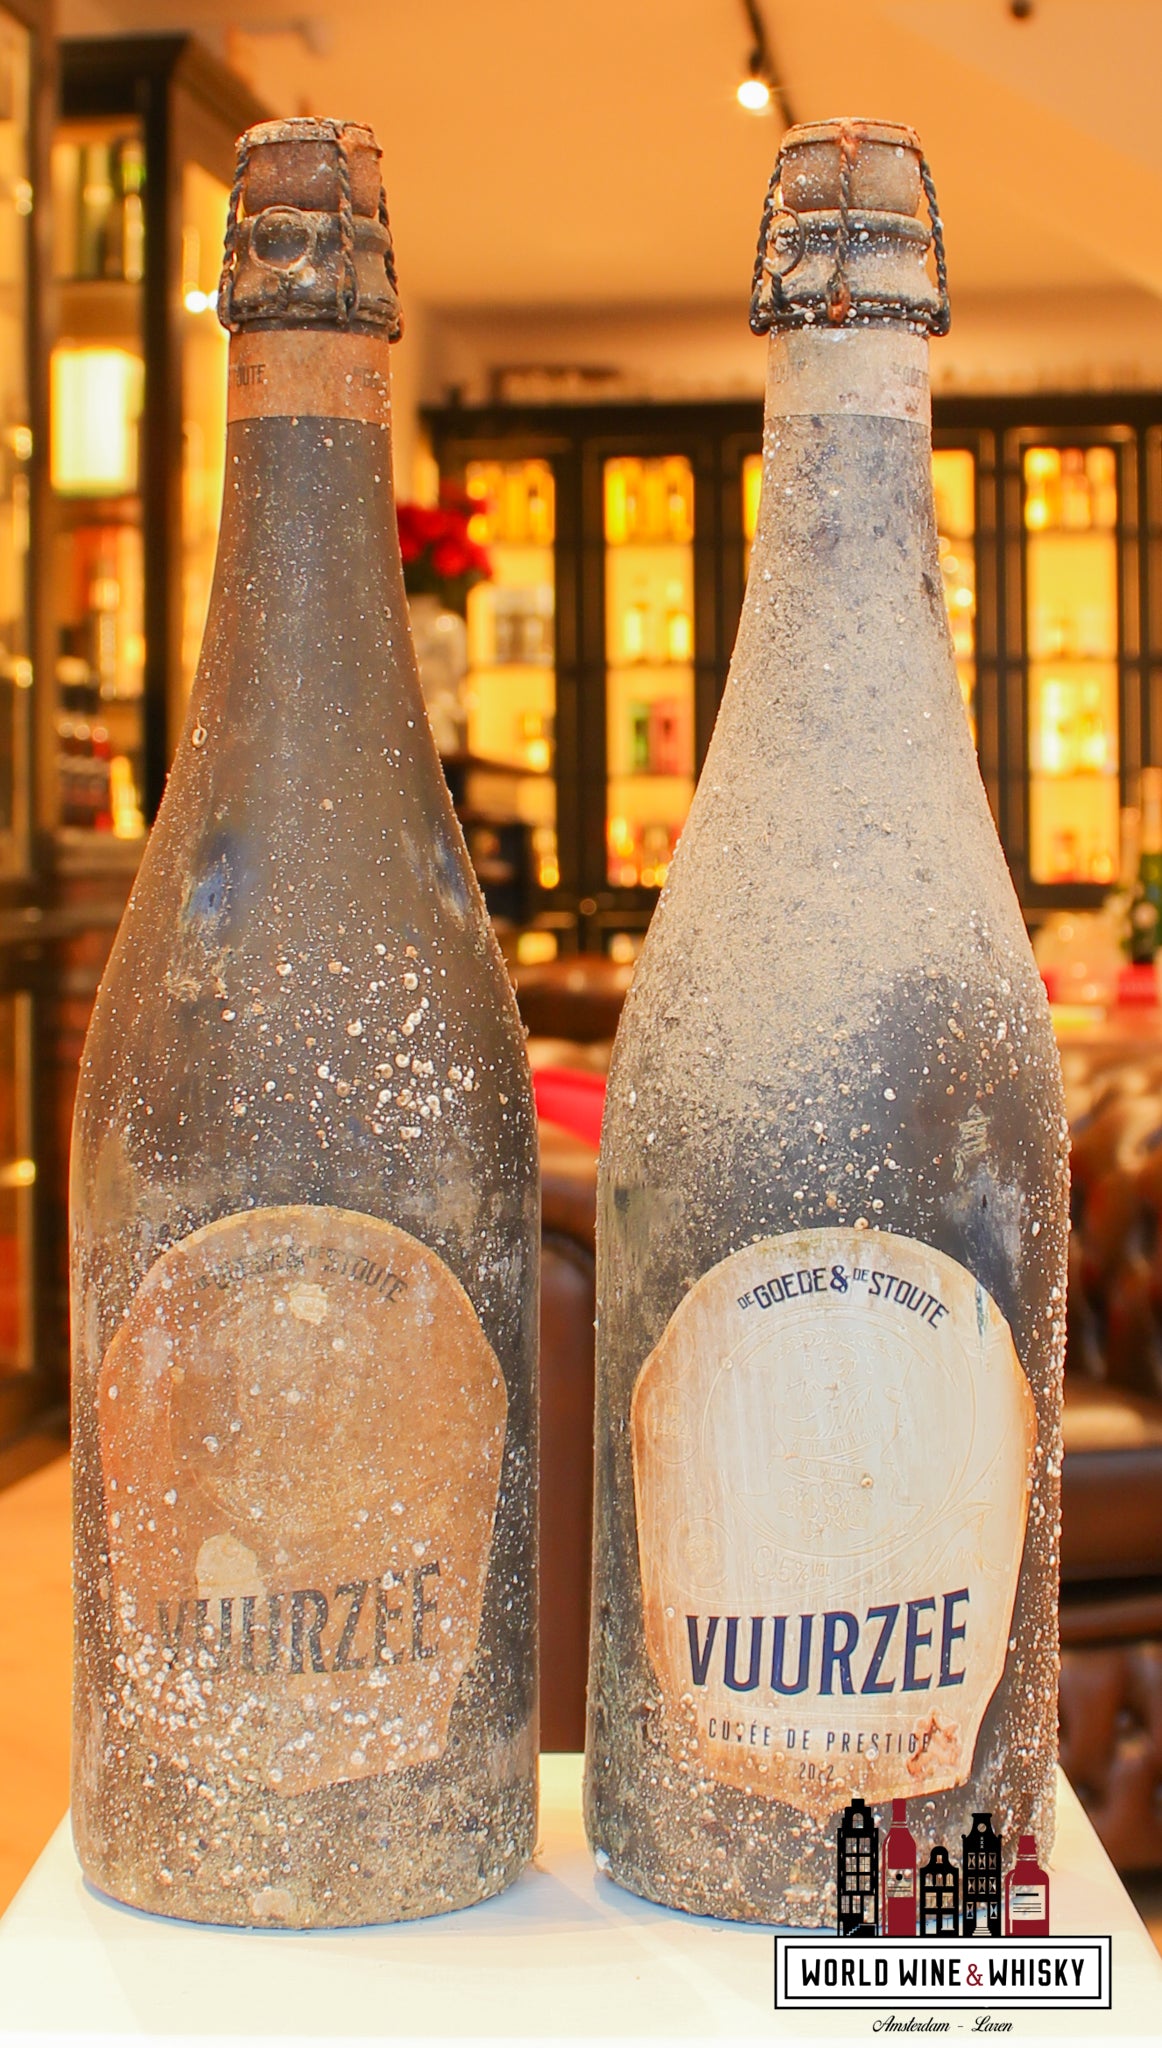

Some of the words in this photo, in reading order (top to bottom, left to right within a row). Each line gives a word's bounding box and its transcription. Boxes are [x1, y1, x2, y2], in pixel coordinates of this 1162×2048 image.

[737, 1291, 755, 1310] DE
[752, 1267, 828, 1310] GOEDE
[829, 1264, 849, 1294] &
[852, 1267, 870, 1282] DE
[868, 1271, 950, 1330] STOUTE
[157, 1560, 441, 1676] VUURZEE
[685, 1586, 970, 1696] VUURZEE
[787, 1728, 810, 1750] DE
[827, 1731, 929, 1754] PRESTIGE
